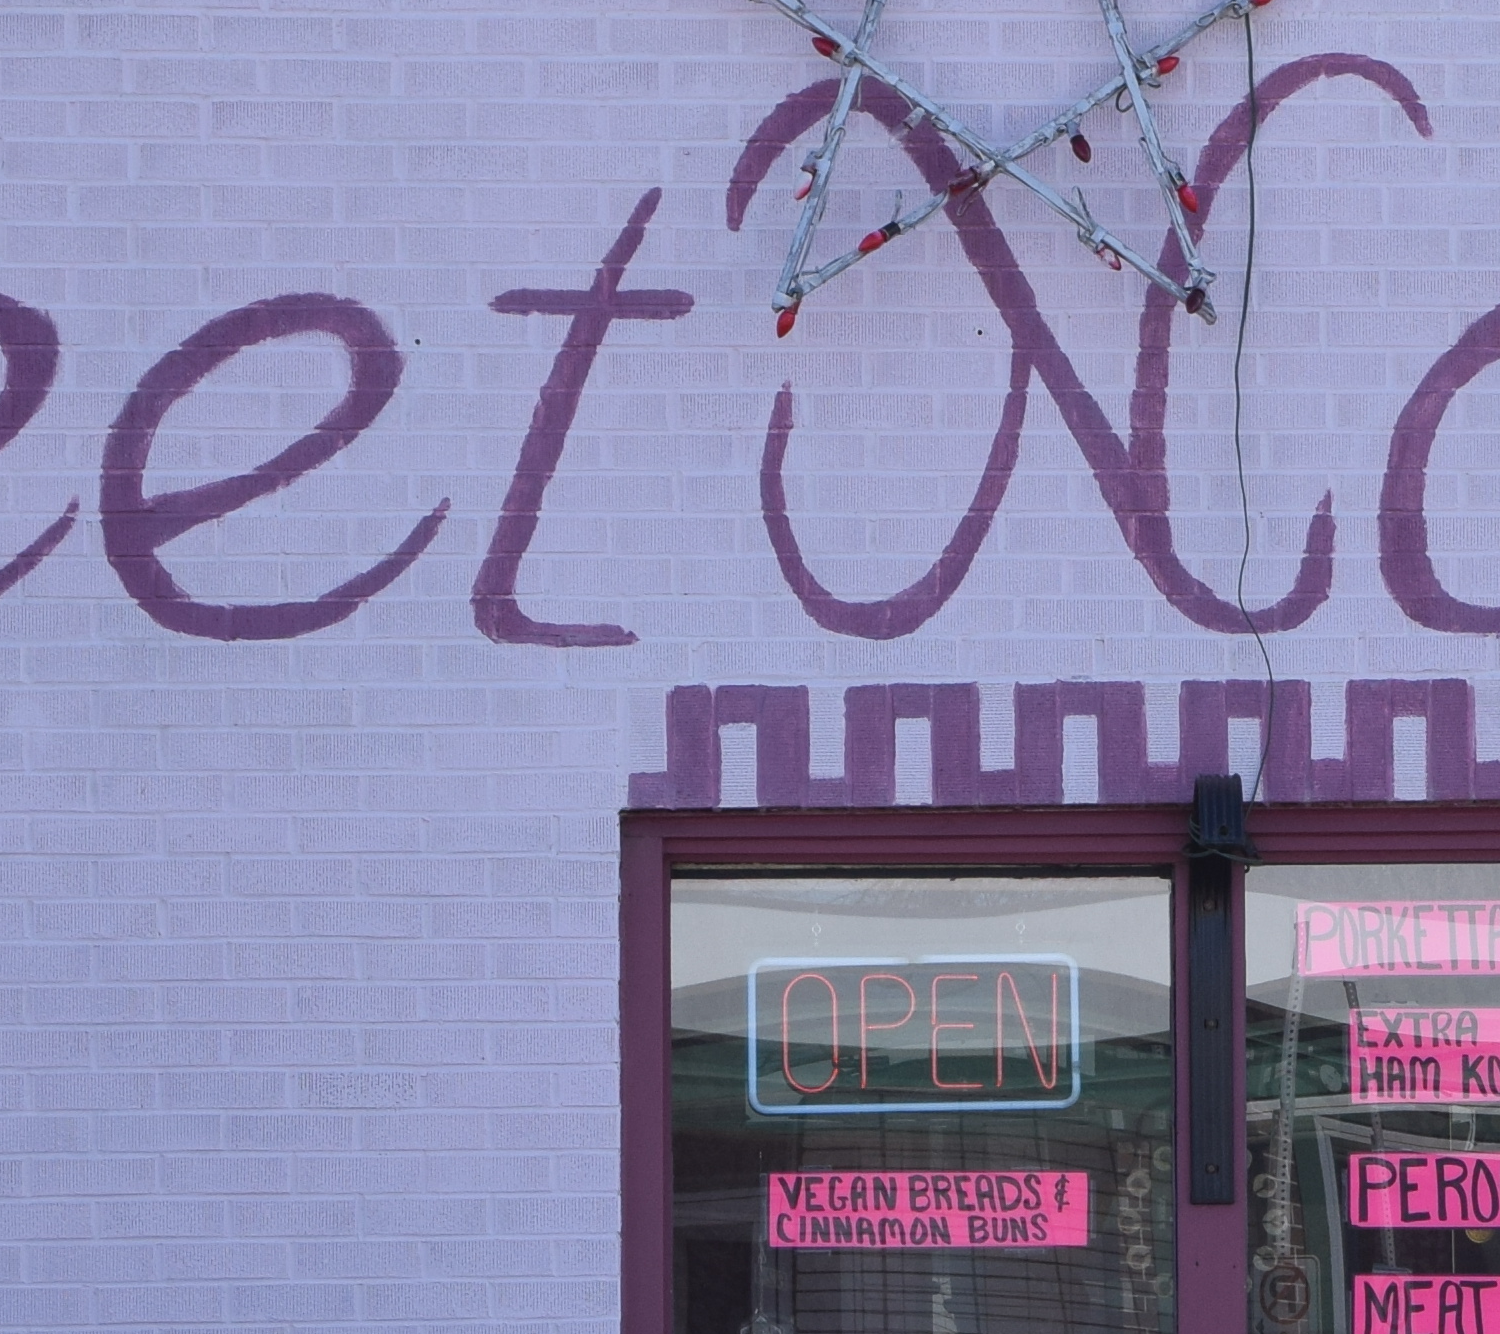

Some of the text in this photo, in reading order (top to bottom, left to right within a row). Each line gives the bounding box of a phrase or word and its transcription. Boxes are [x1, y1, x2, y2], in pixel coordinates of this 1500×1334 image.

[781, 971, 1060, 1093] OPEN
[1355, 1013, 1480, 1049] EXTRA
[1357, 1057, 1444, 1099] HAM
[778, 1173, 1071, 1213] VEGAN BREADS &
[776, 1211, 1049, 1245] CINNAMON BUNS
